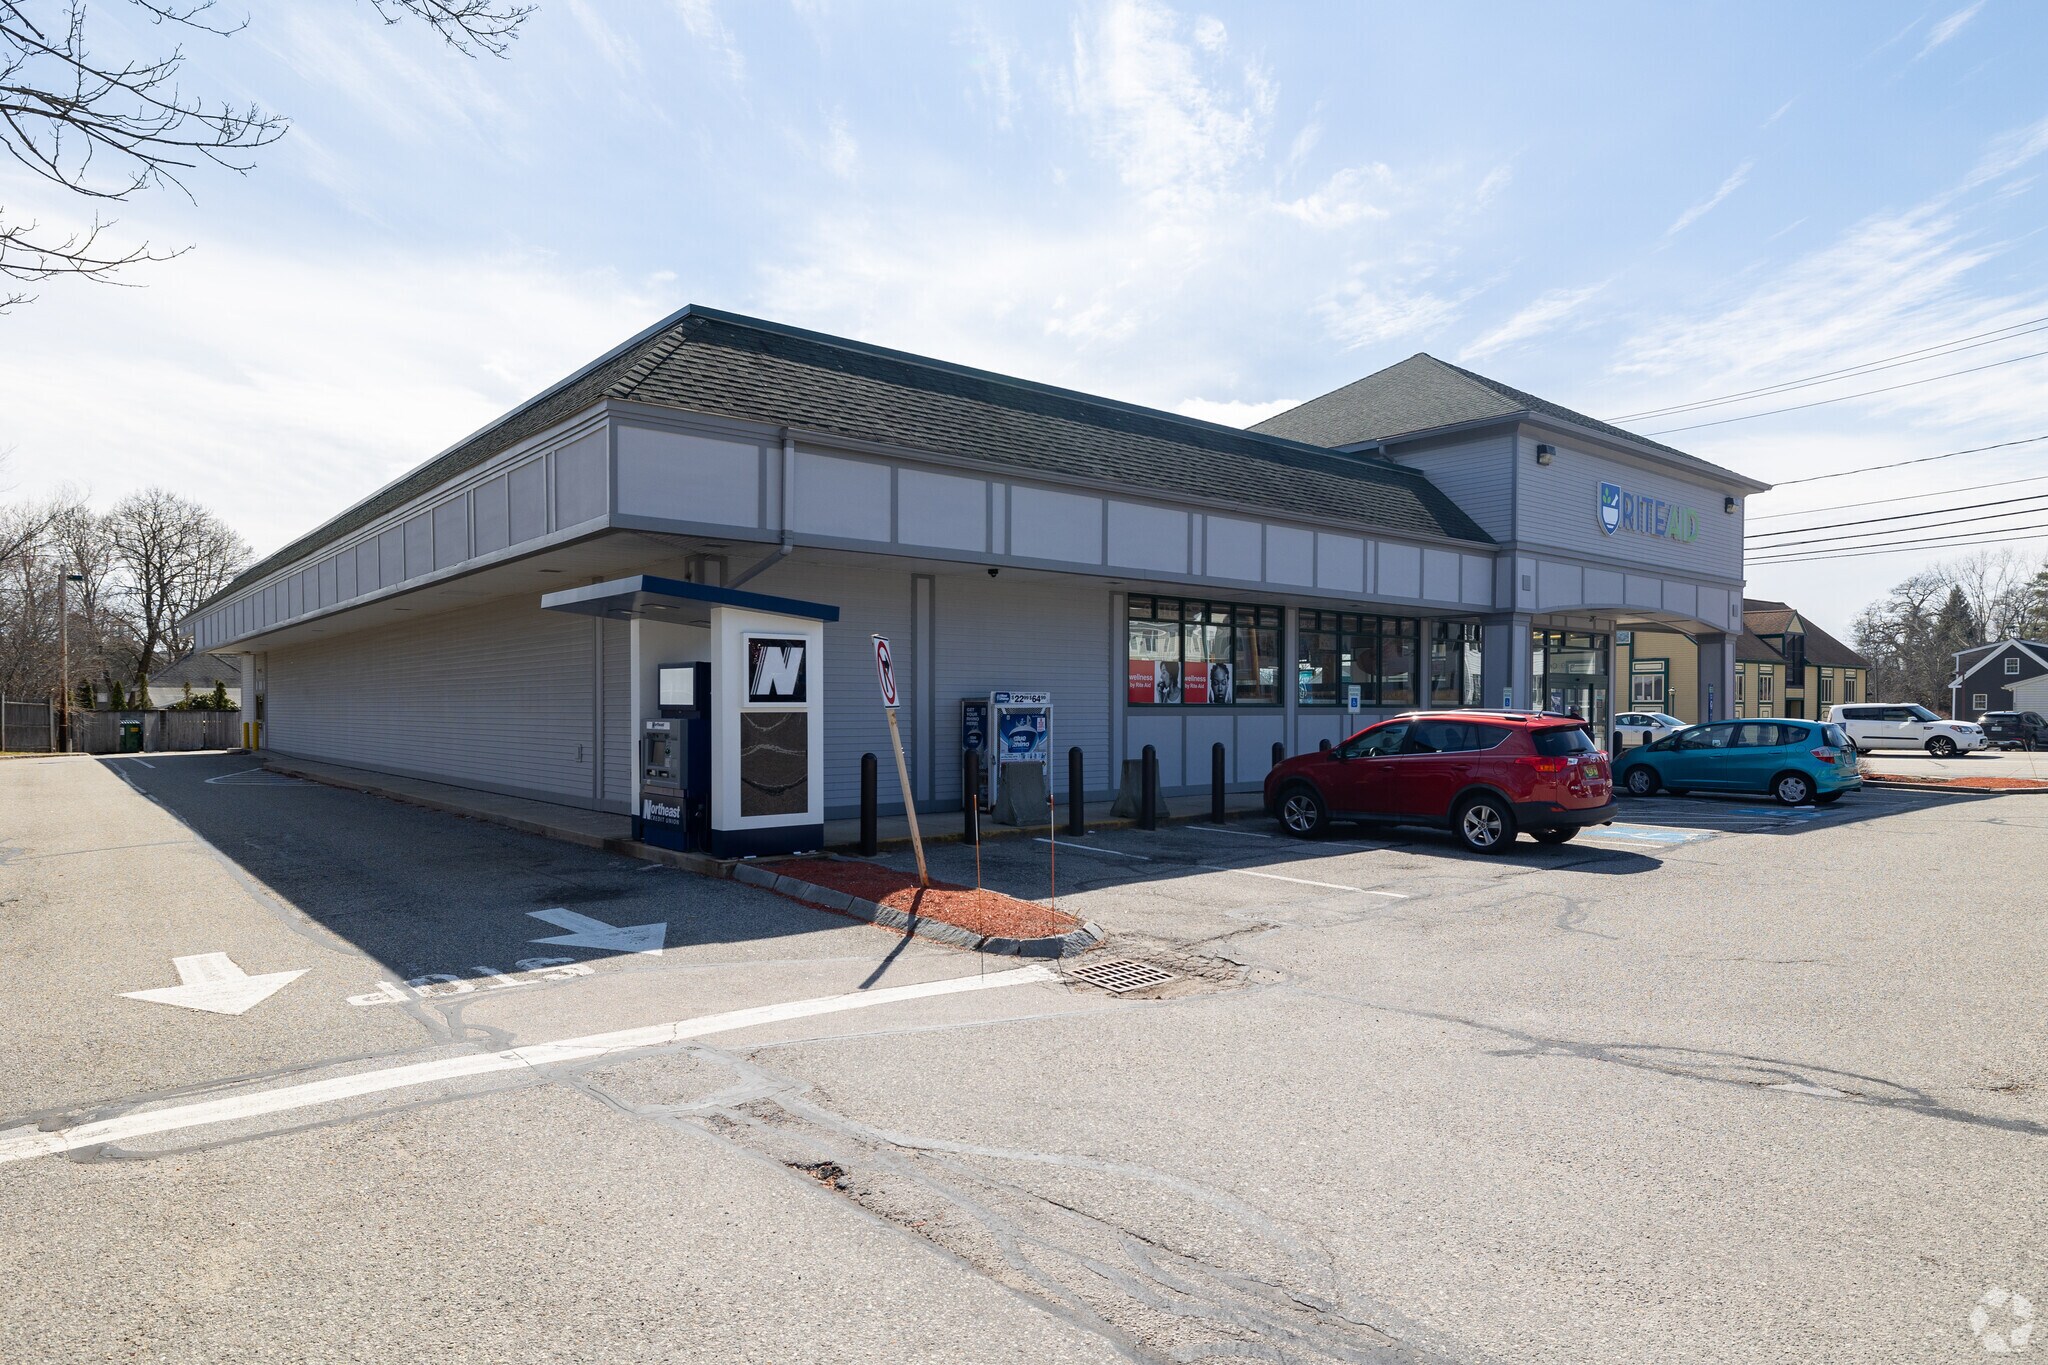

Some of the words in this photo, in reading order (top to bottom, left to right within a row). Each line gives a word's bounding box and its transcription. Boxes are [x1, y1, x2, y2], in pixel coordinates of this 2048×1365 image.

[1622, 492, 1666, 536] RITE
[1666, 504, 1700, 543] AID
[750, 646, 804, 696] N
[643, 799, 680, 820] Northeast
[665, 817, 680, 825] UNION
